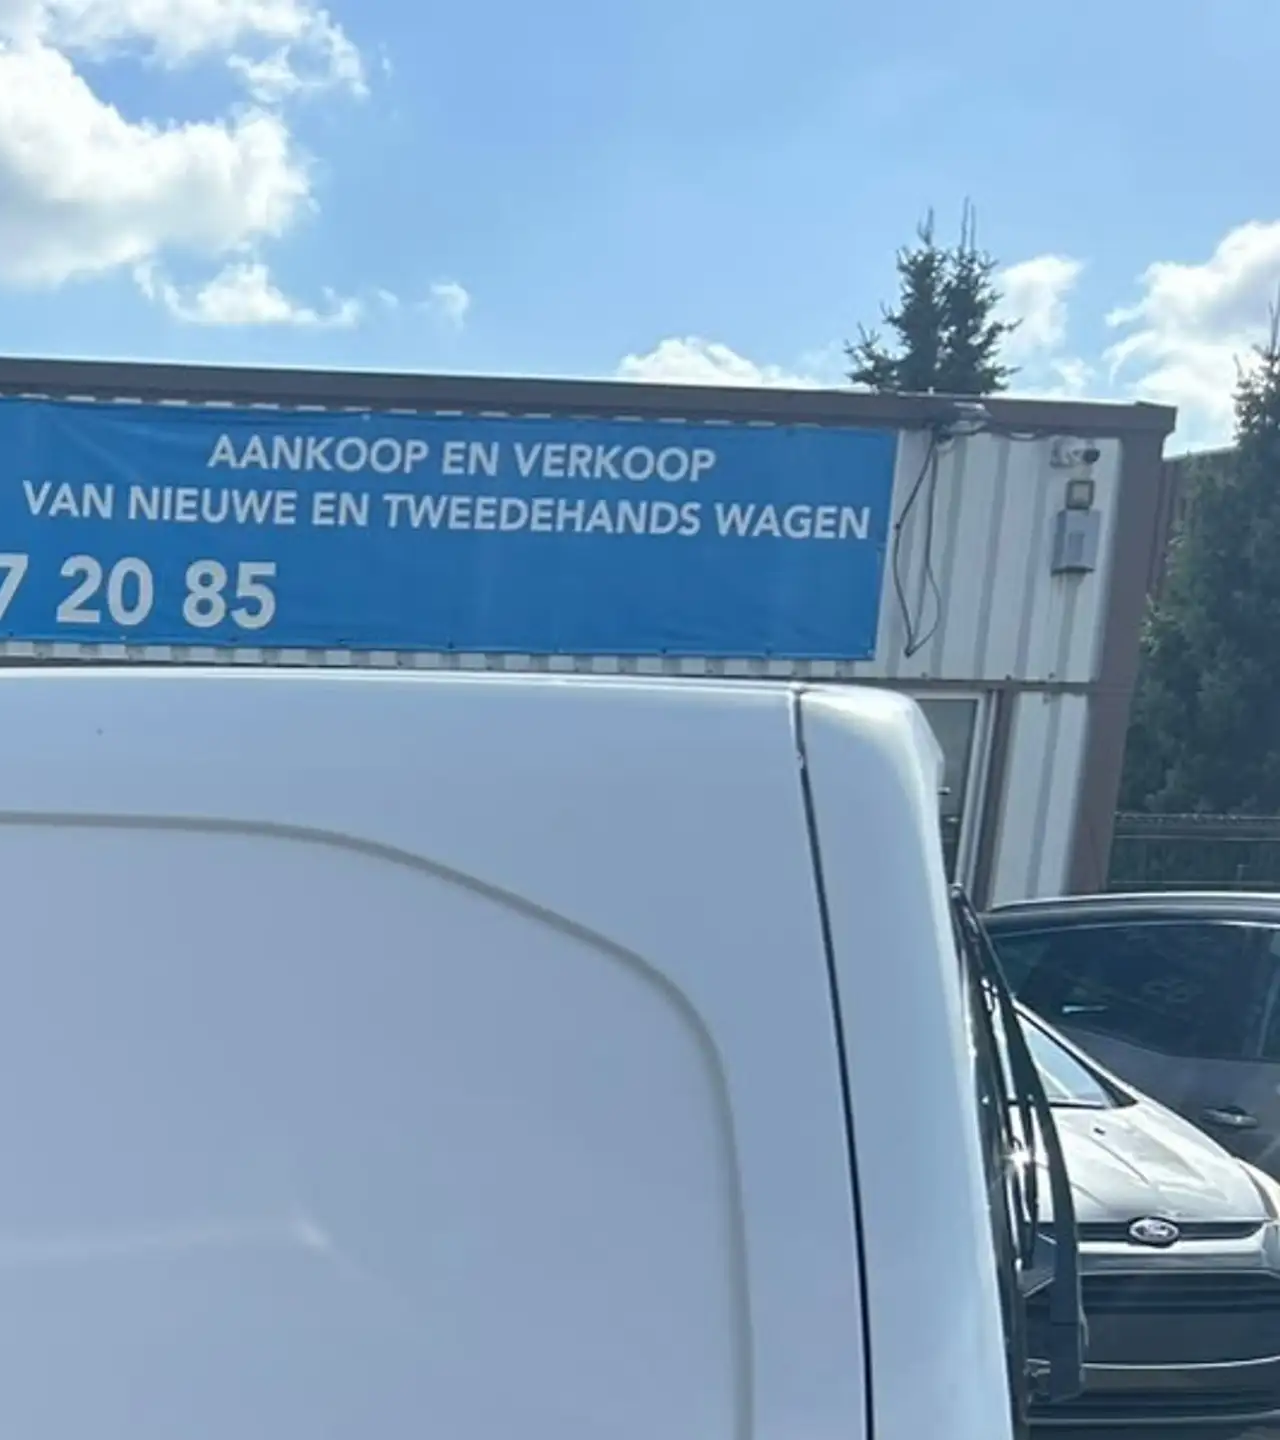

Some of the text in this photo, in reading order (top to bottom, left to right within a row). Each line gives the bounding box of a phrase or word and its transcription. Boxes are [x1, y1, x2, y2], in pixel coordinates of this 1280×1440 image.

[207, 435, 716, 481] AANKOOP EN VERKOOP
[22, 481, 871, 540] VAN NIEUWE EN TWEEDEHANDS WAGEN
[55, 555, 154, 627] 20
[182, 560, 276, 630] 85
